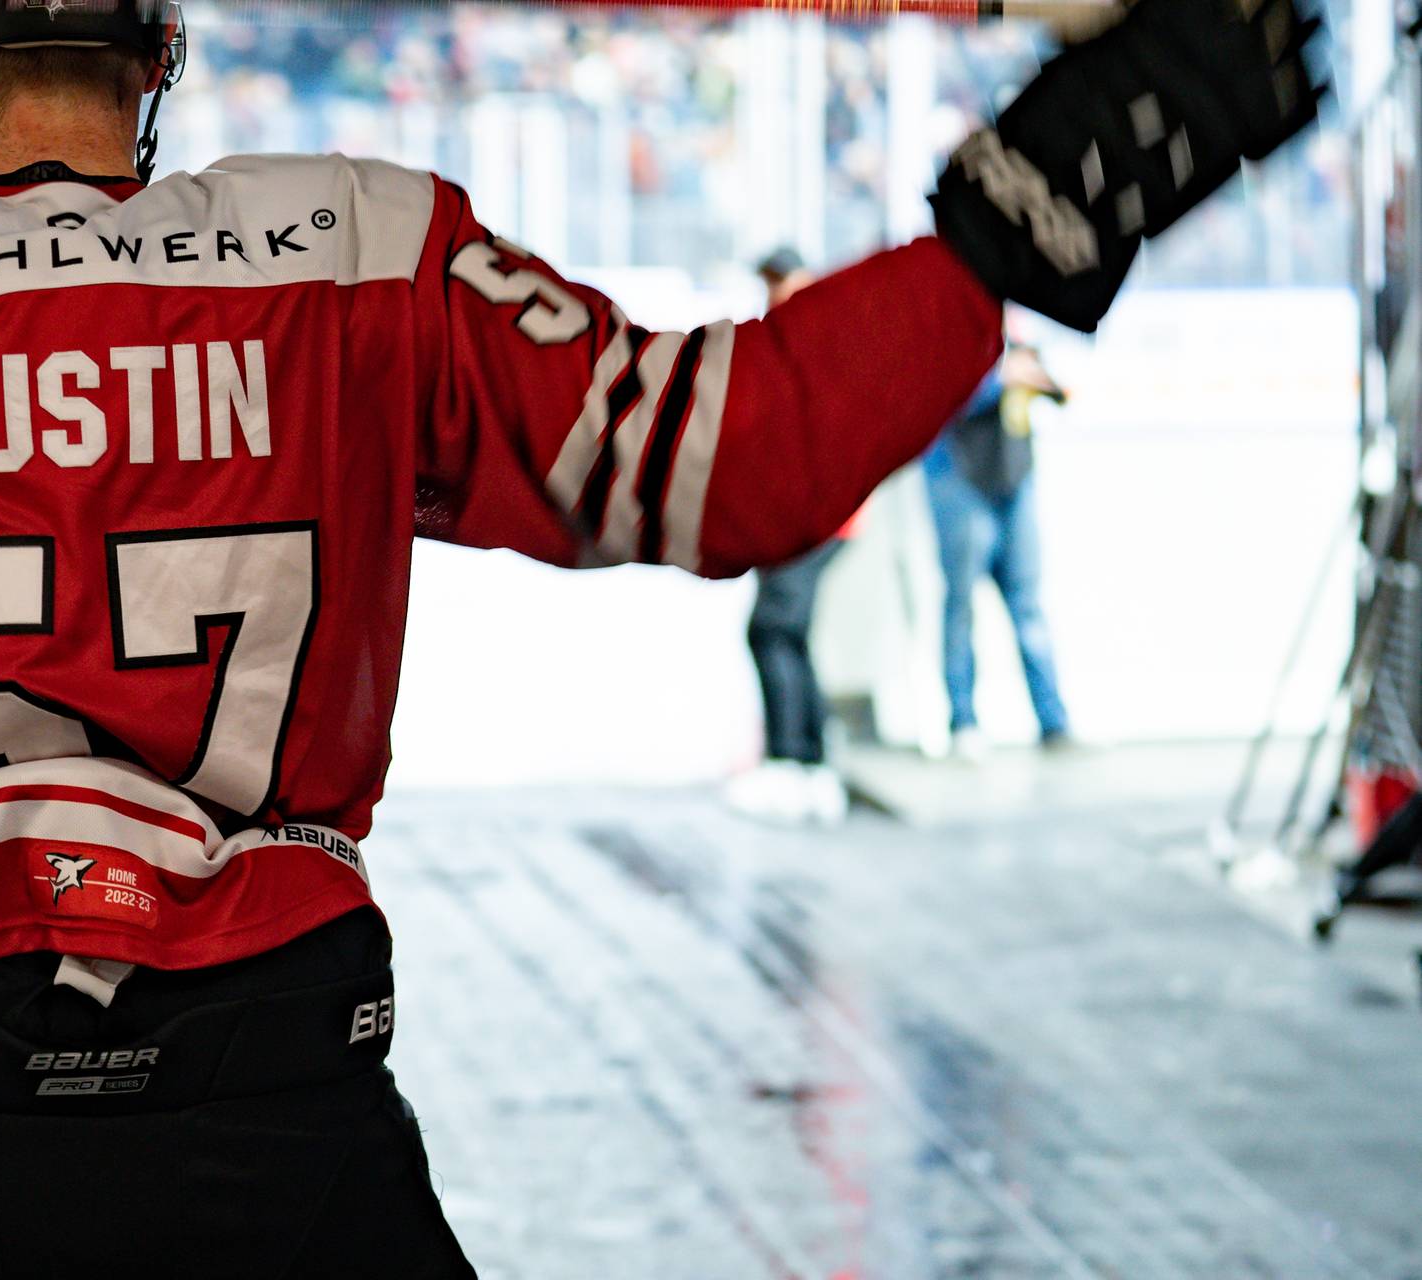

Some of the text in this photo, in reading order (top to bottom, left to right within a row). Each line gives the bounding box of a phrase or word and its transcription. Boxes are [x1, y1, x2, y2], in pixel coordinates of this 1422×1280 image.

[447, 235, 593, 346] 5
[107, 867, 137, 887] HOME
[104, 888, 151, 913] 2022-23
[45, 1080, 95, 1091] PRO
